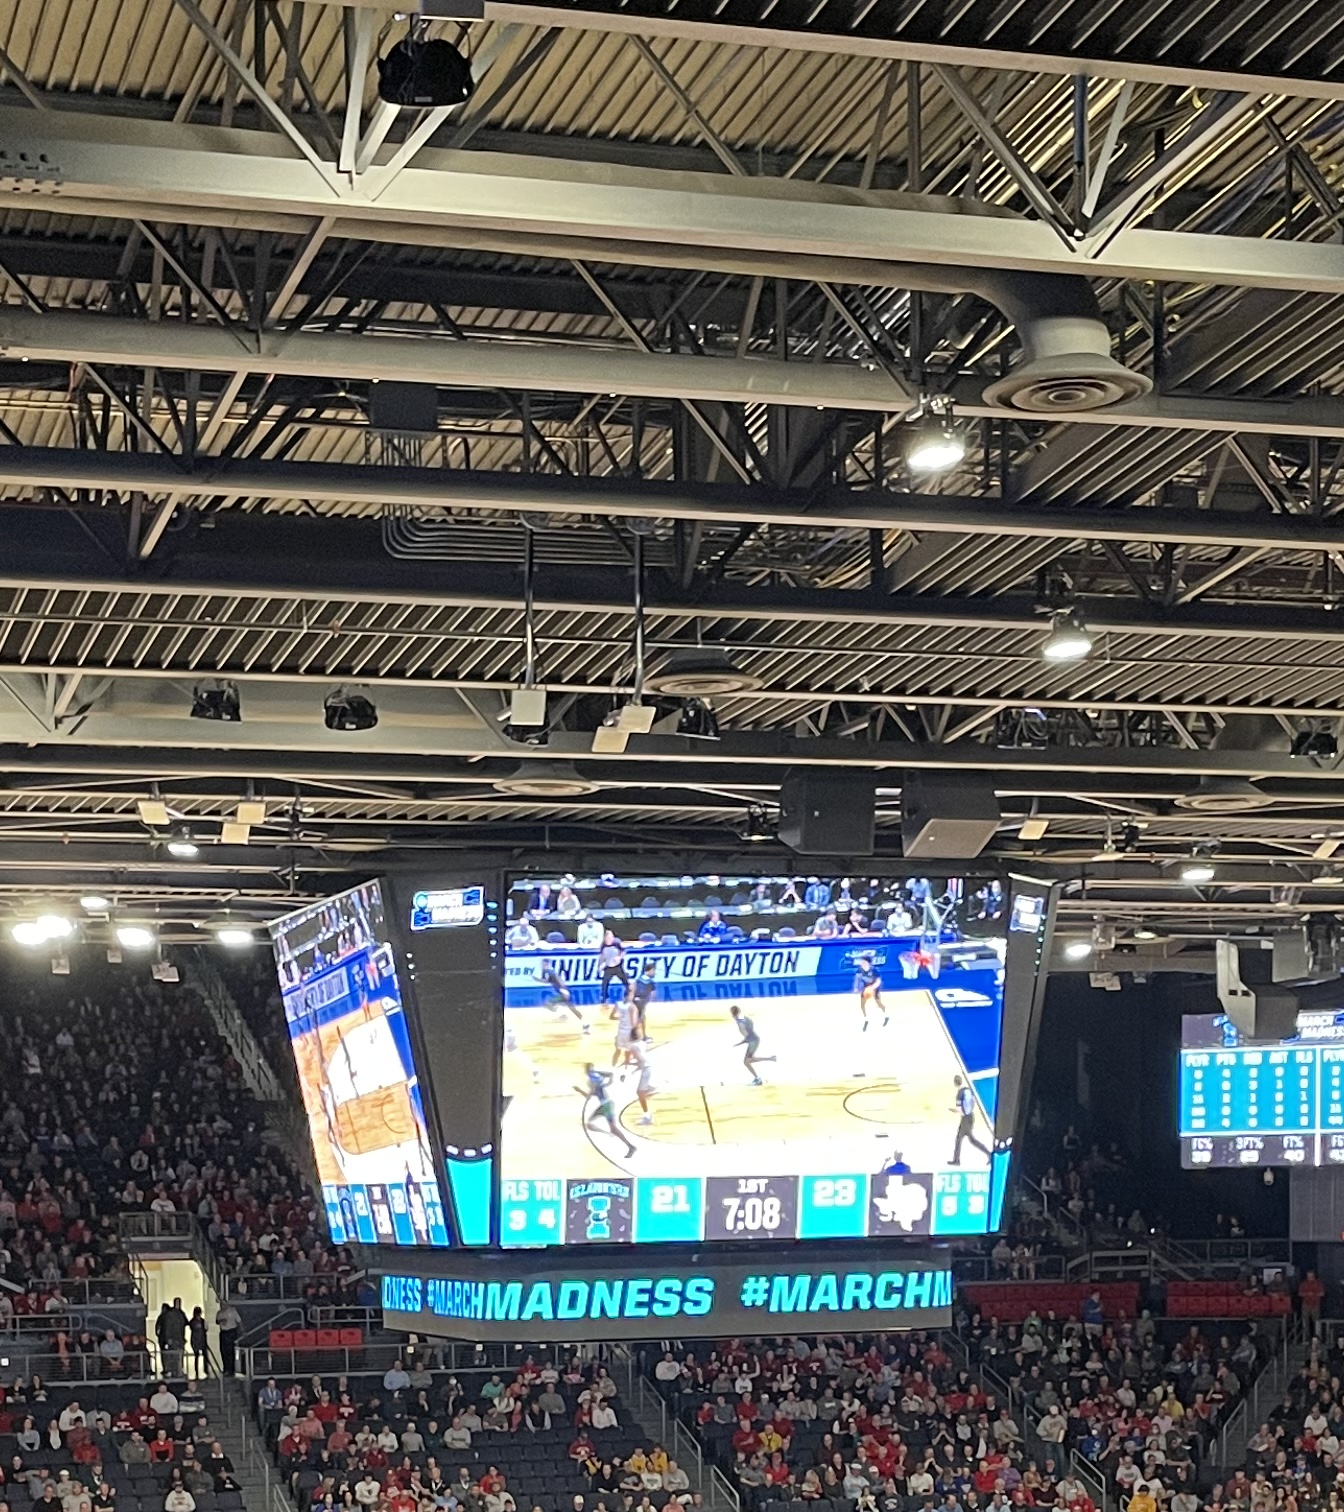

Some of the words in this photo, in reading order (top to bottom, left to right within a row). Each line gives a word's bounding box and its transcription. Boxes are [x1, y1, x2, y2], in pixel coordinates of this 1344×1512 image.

[683, 955, 709, 978] OF
[716, 950, 800, 976] DAYTON
[504, 1181, 528, 1201] FLS
[534, 1181, 560, 1201] TOL
[737, 1179, 768, 1193] 1ST
[936, 1174, 961, 1192] FLS
[651, 1185, 690, 1213] 21
[509, 1210, 526, 1230] 3
[538, 1208, 554, 1229] 4
[722, 1198, 781, 1230] 7:08
